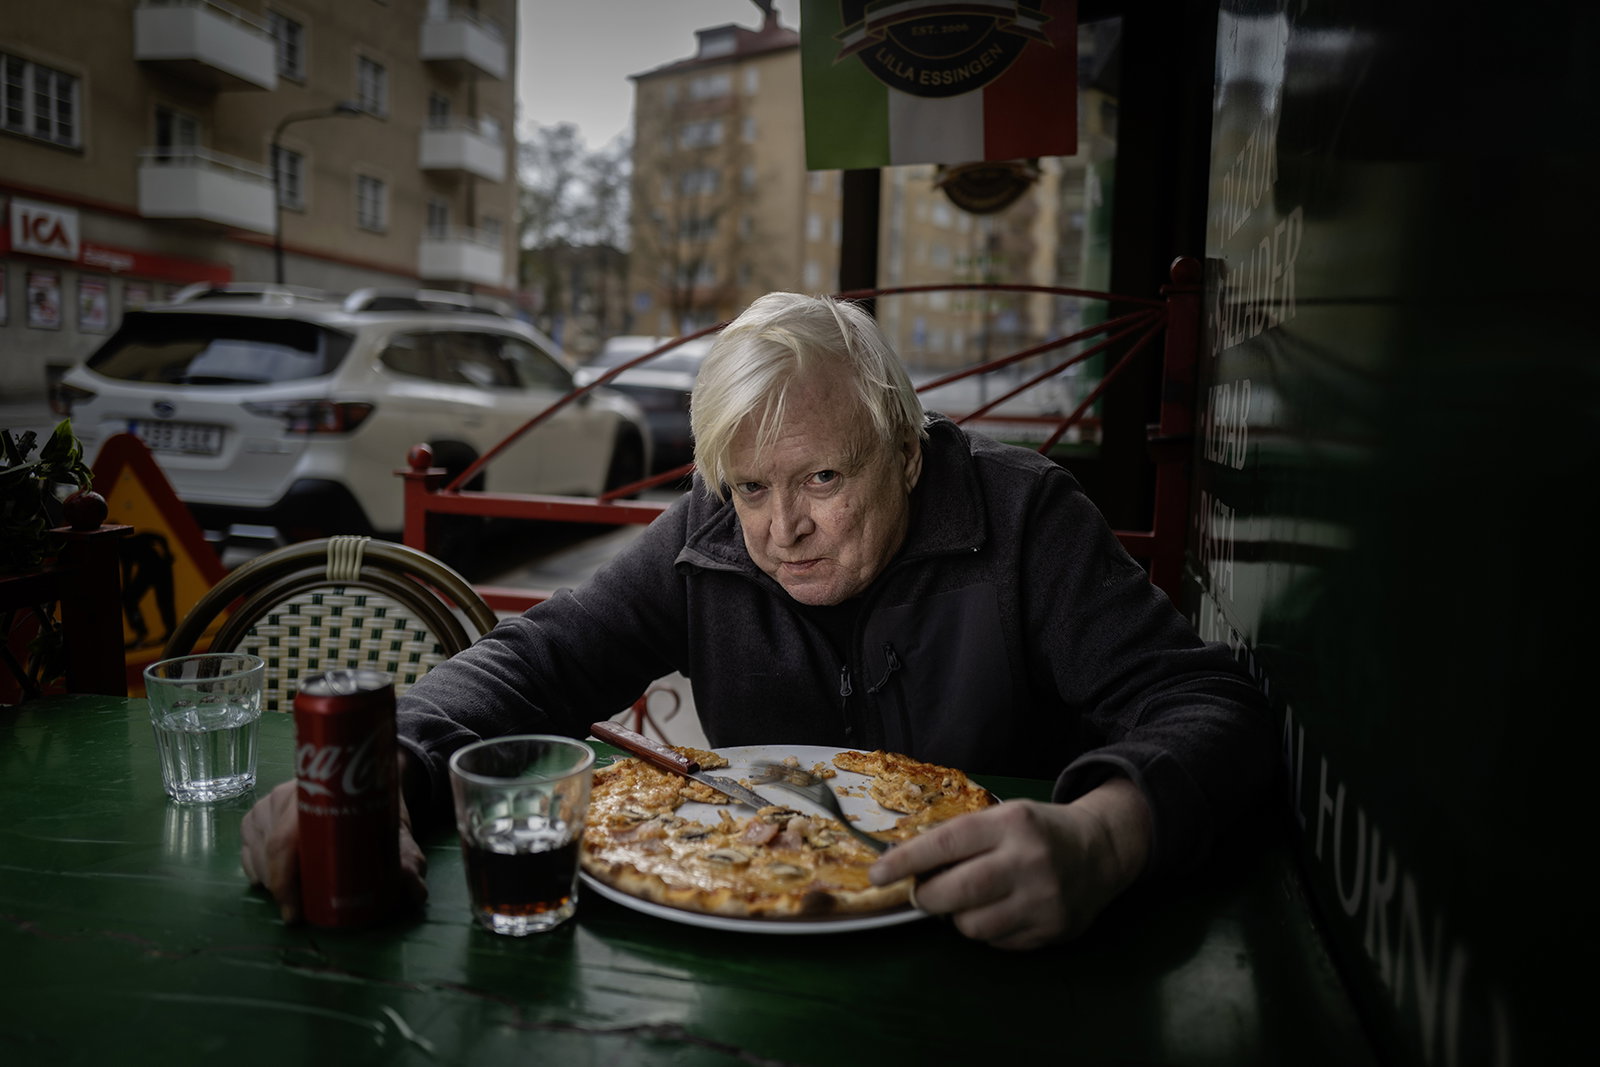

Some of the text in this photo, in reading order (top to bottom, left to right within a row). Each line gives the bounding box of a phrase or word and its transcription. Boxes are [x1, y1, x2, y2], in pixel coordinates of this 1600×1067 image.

[874, 43, 1004, 86] LILLA ESSINGEN
[21, 212, 71, 249] ICA
[1212, 205, 1304, 358] SALLADER
[1203, 378, 1252, 472] KEBAB
[1198, 489, 1236, 602] PASTA
